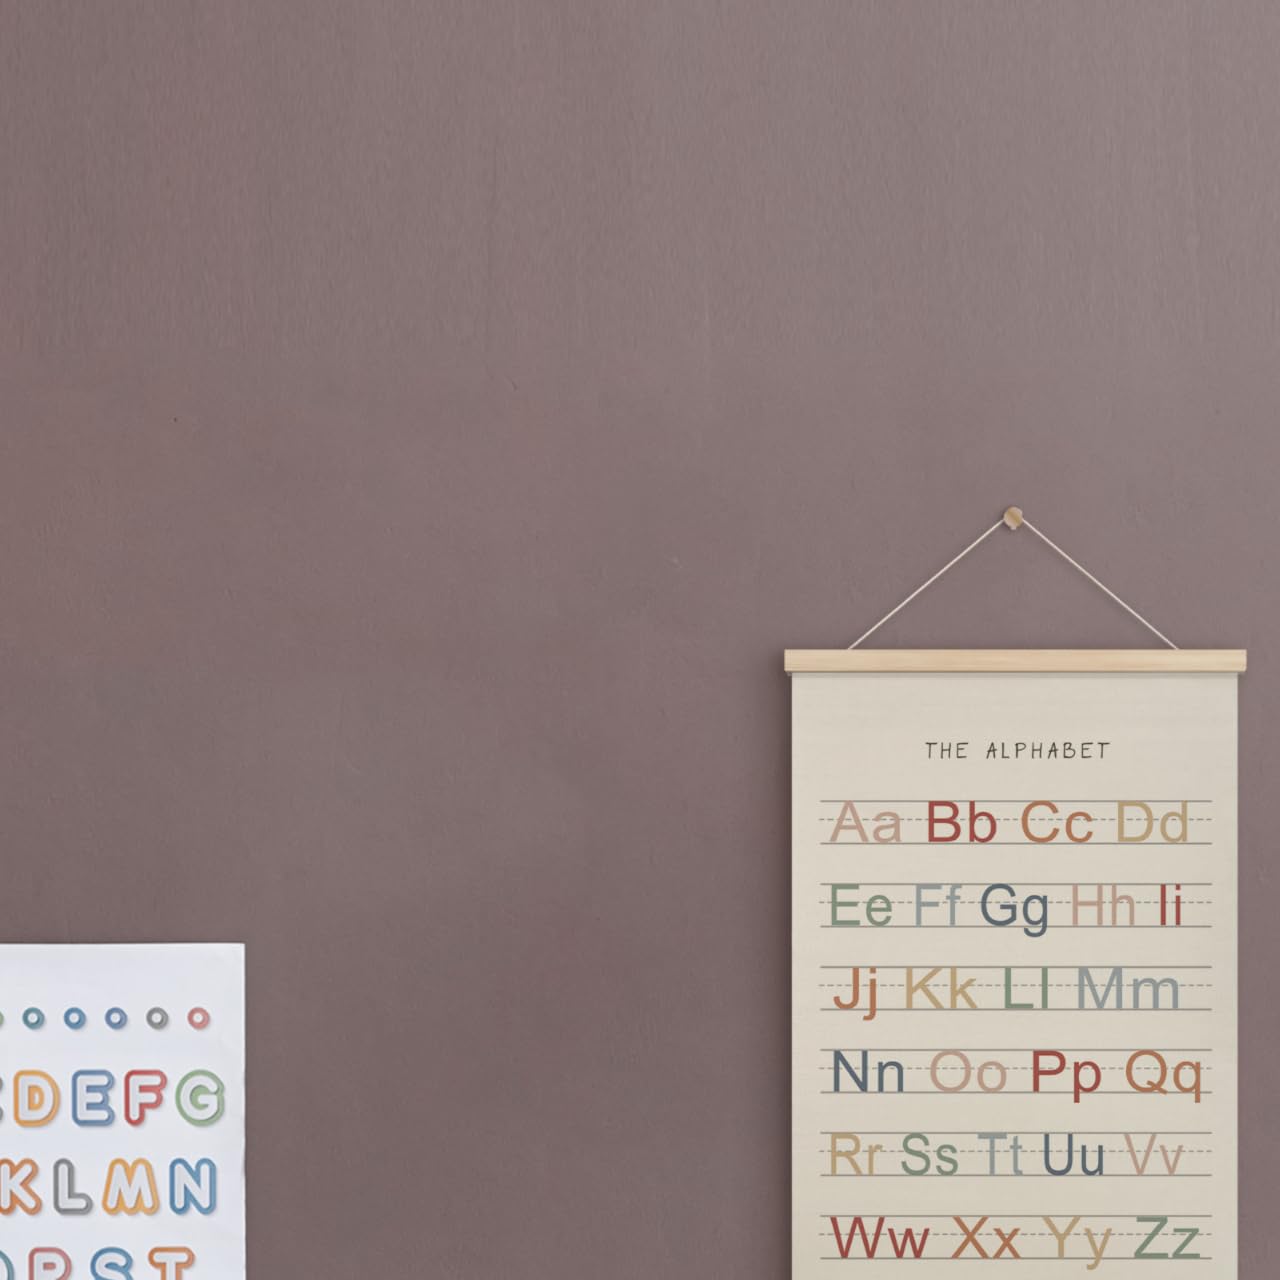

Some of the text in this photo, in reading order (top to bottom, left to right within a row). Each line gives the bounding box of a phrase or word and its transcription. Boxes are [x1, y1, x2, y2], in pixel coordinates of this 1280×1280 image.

[925, 741, 1112, 760] THE ALPHABET
[828, 799, 1189, 844] Aa Bb Cc Dd
[829, 882, 1182, 938] Ee Ff Gg Hh Ii
[832, 965, 1179, 1021] Jj Kk Ll Mm
[830, 1047, 1202, 1103] Nn Oo Pp Qq
[828, 1131, 1184, 1177] Rr Ss Tt Uu Vv
[829, 1214, 1201, 1270] Ww Xx Yy Zz
